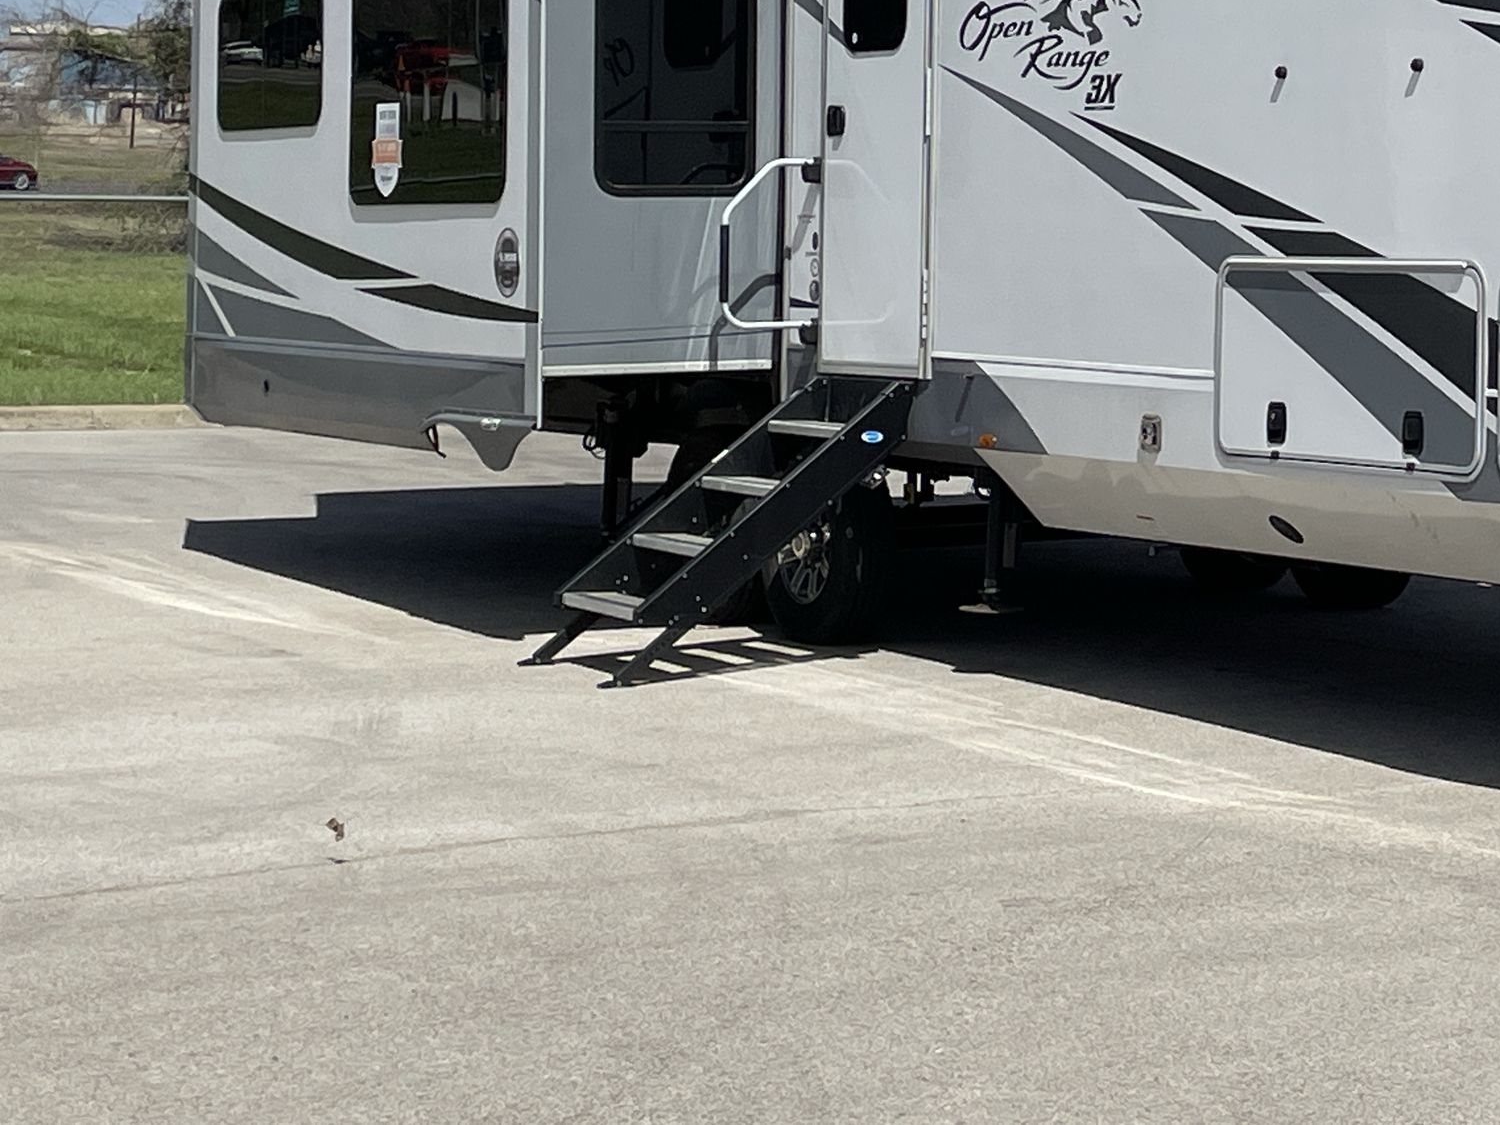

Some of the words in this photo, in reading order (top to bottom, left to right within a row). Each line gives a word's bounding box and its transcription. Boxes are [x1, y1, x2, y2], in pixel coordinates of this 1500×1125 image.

[960, 1, 1037, 61] Open
[1013, 35, 1110, 90] Range
[1085, 73, 1123, 105] 3X
